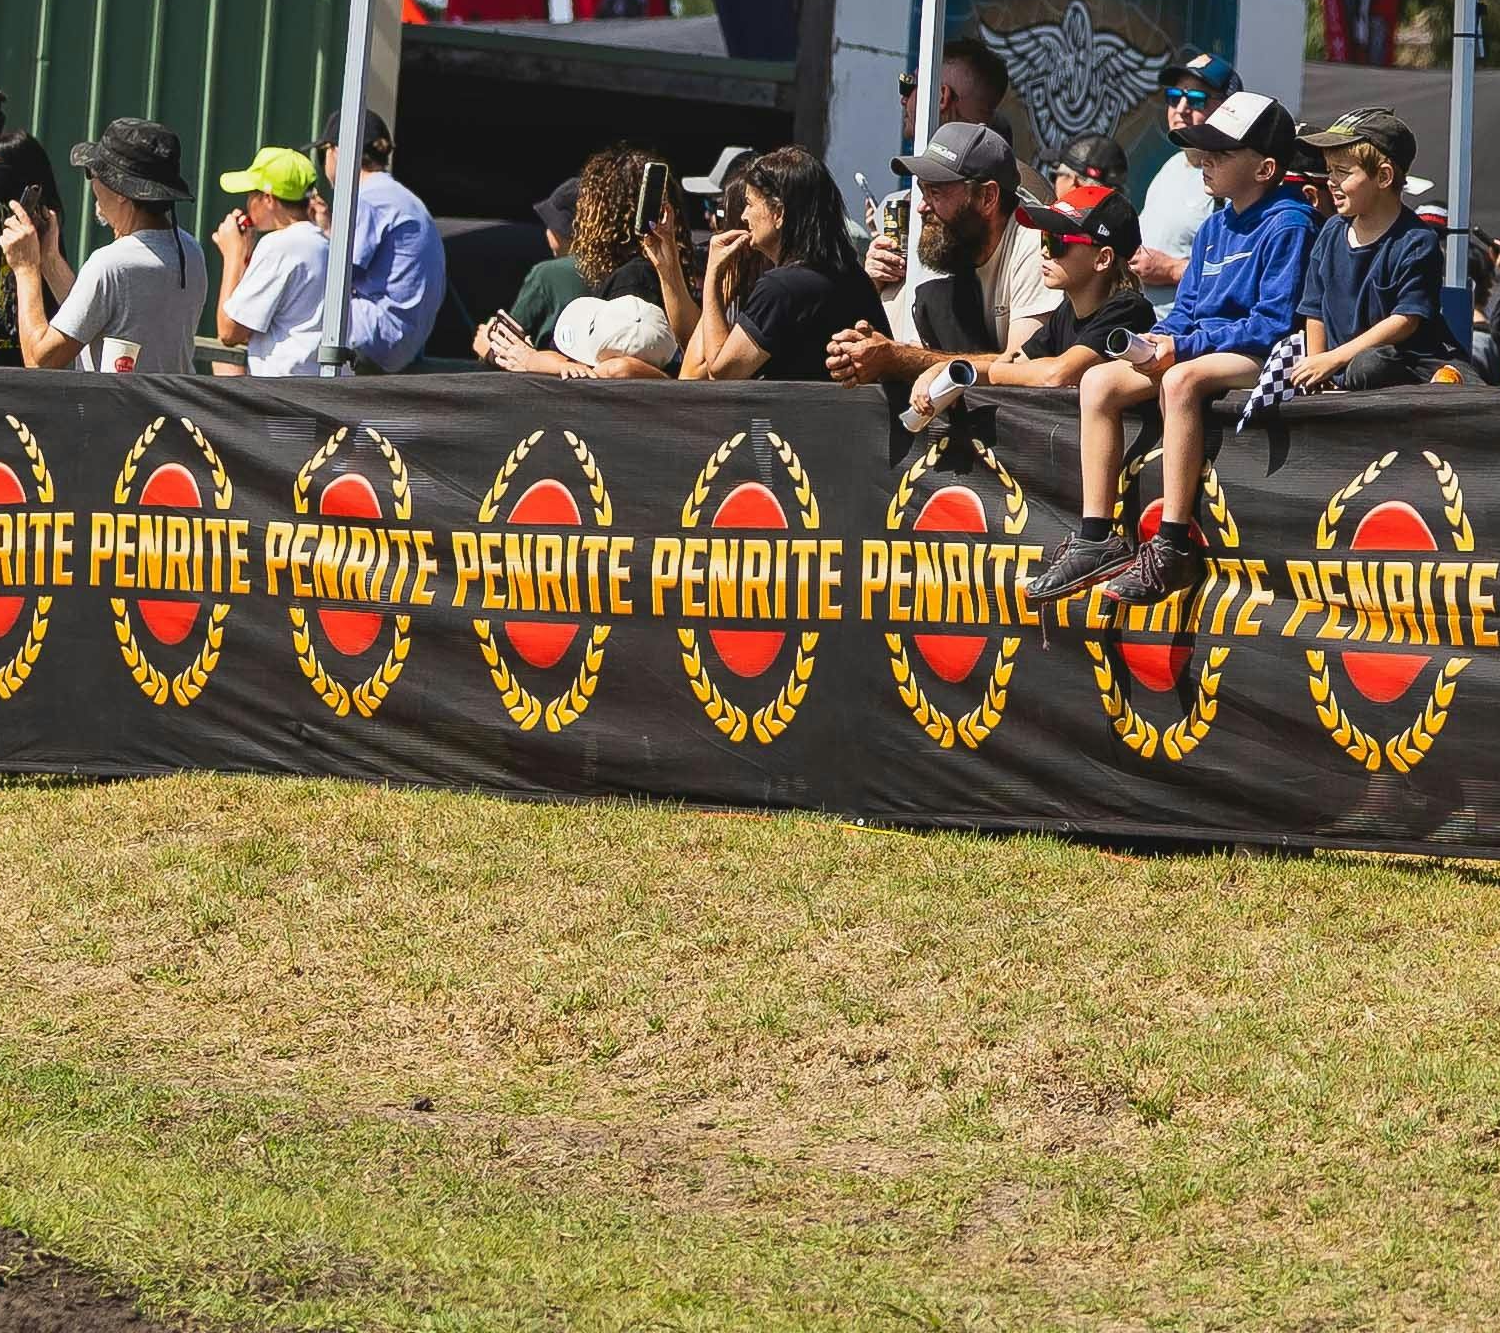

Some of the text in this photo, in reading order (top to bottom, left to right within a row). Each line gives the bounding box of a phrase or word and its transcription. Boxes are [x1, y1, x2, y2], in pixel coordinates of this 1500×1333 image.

[89, 512, 252, 595] PENRITE
[263, 521, 439, 607] PENRITE
[451, 530, 635, 615] PENRITE
[651, 536, 844, 622] PENRITE
[860, 539, 1045, 627] PENRITE
[1282, 559, 1500, 647] PENRITE
